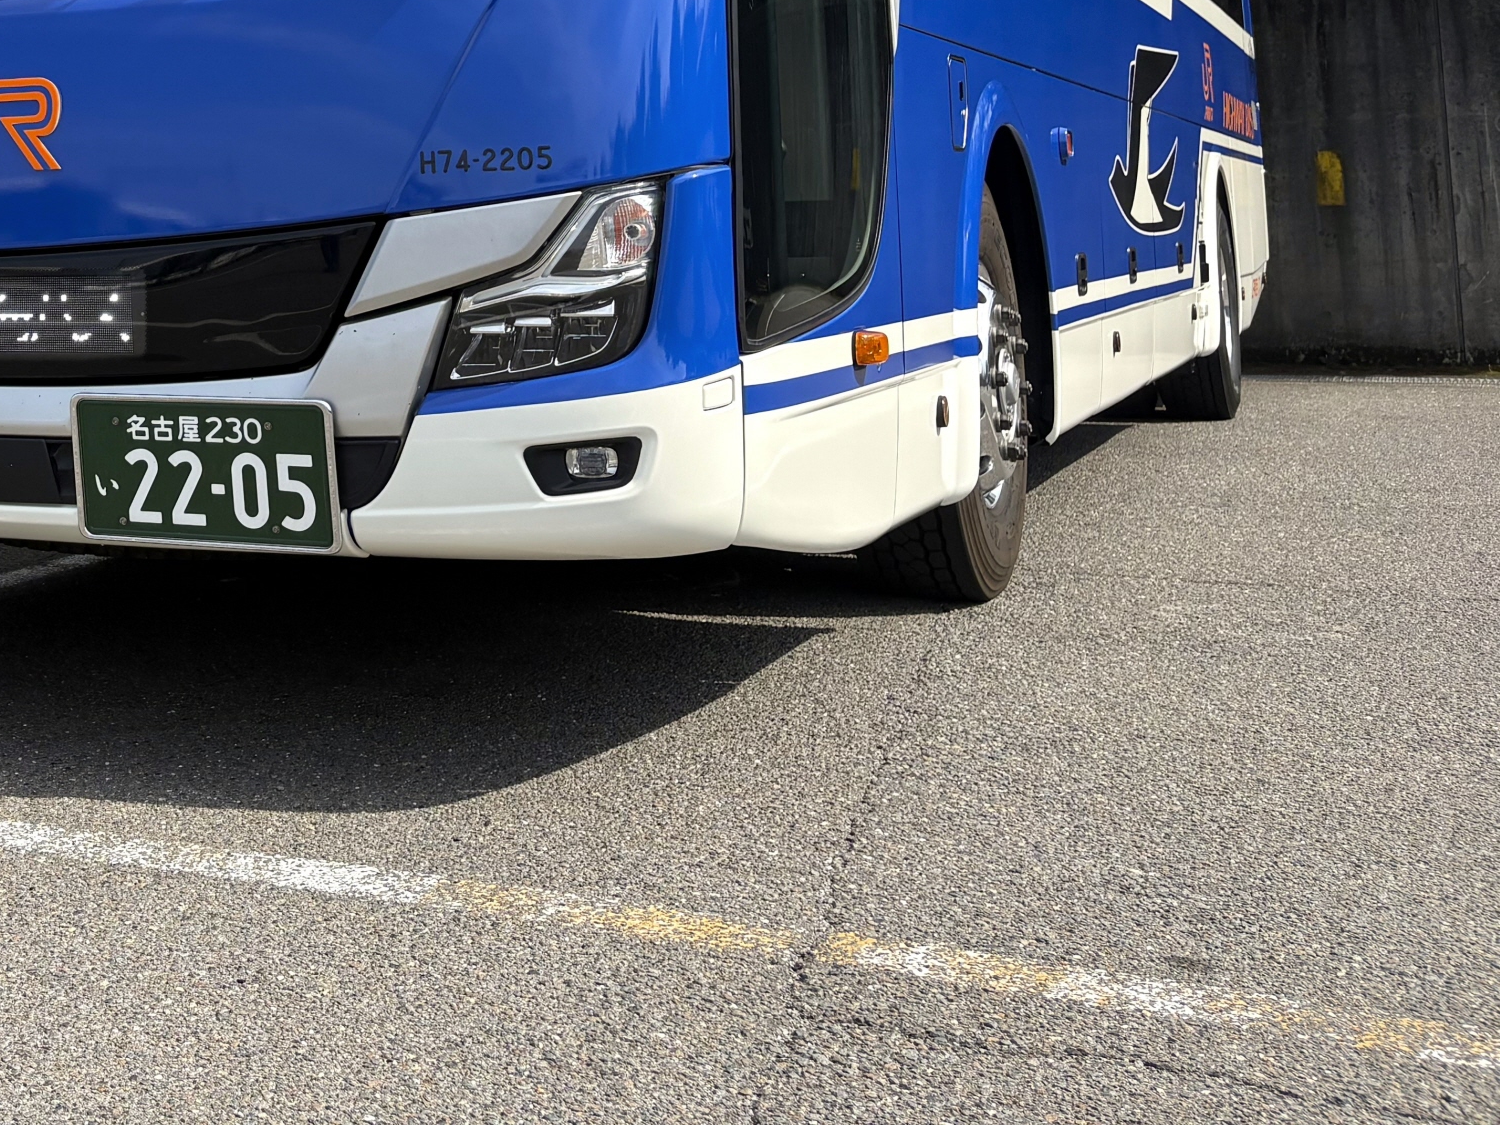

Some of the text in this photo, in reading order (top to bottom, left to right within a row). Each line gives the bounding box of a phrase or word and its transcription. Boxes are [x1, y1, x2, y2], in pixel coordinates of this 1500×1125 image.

[1202, 42, 1214, 103] JR
[420, 145, 553, 174] H74-2205
[94, 448, 317, 532] い 22-05
